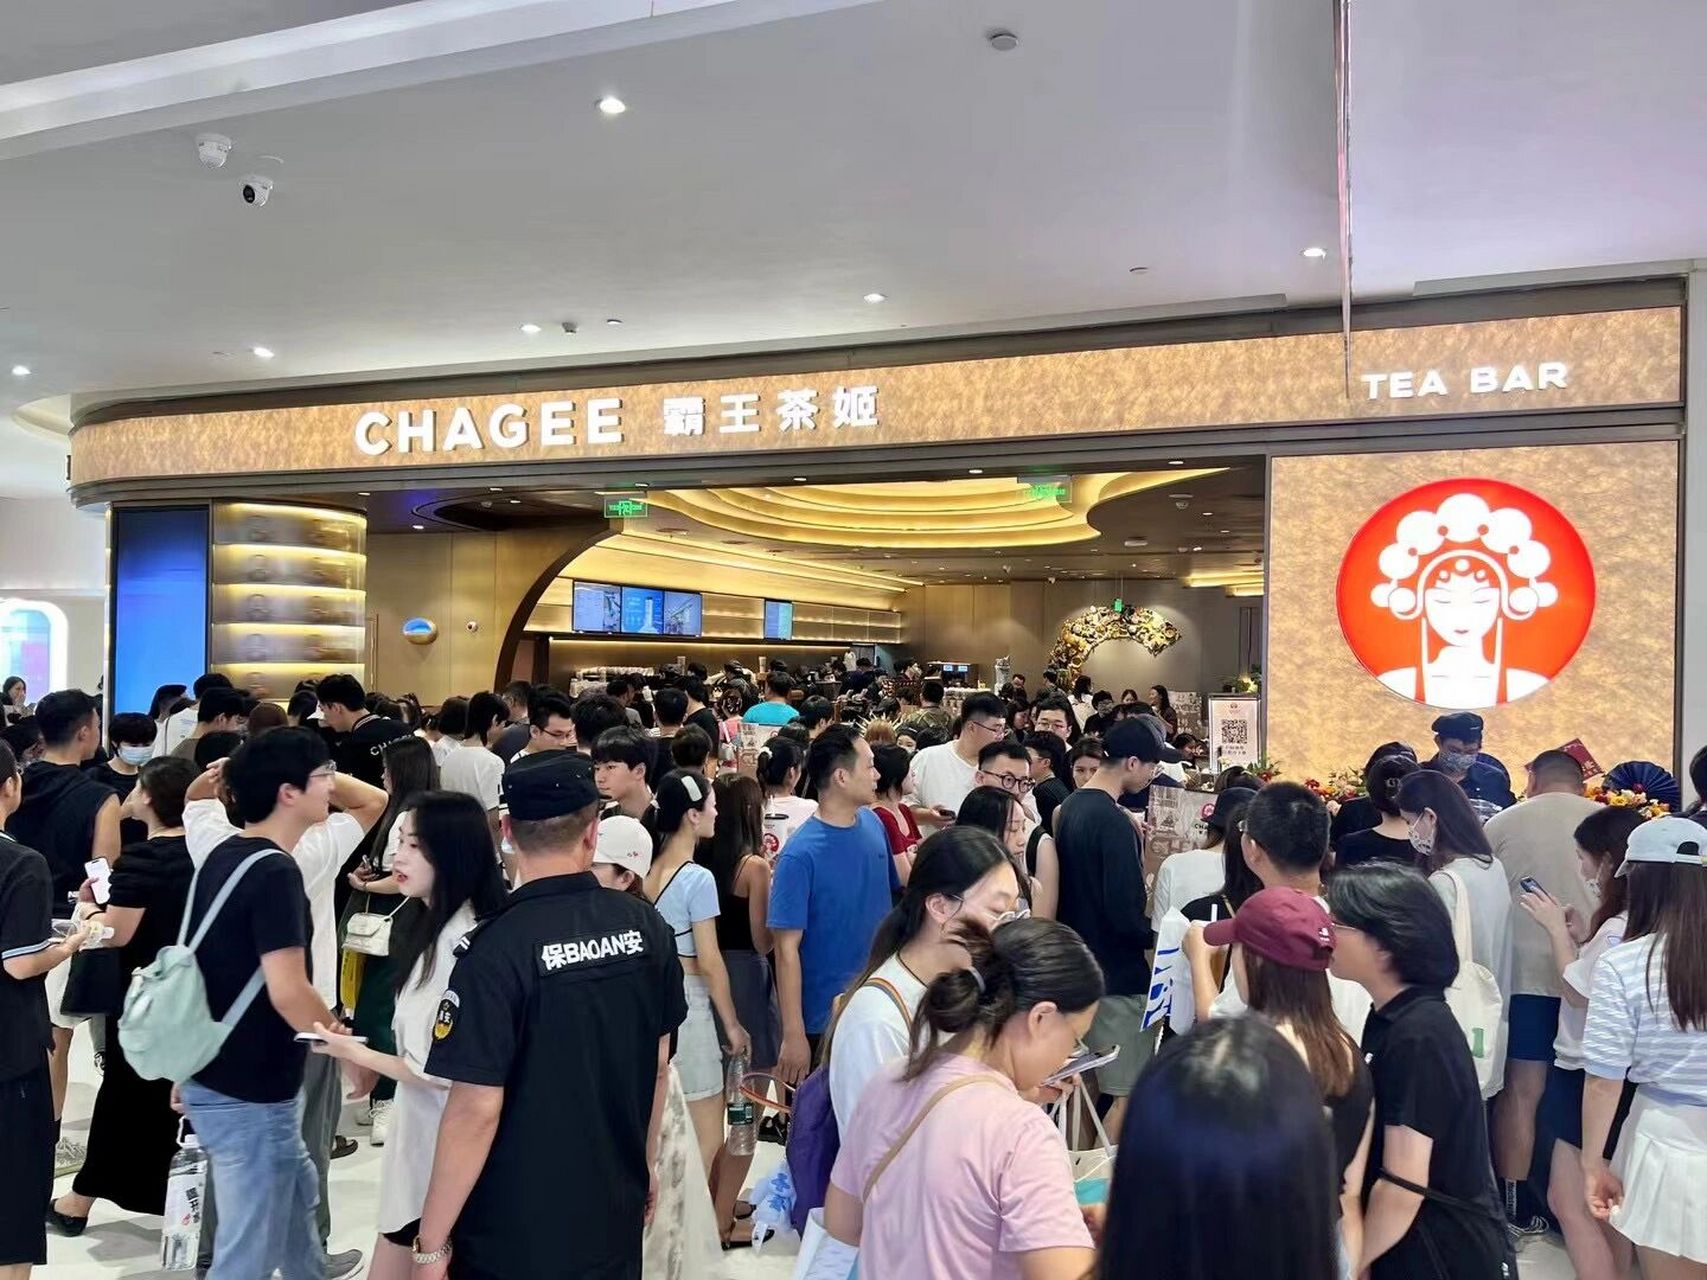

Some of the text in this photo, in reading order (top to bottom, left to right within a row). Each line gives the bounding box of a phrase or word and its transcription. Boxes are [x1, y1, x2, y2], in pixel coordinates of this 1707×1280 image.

[1360, 362, 1568, 399] TEA BAR
[354, 386, 878, 455] CHAGEE 霸王茶姬
